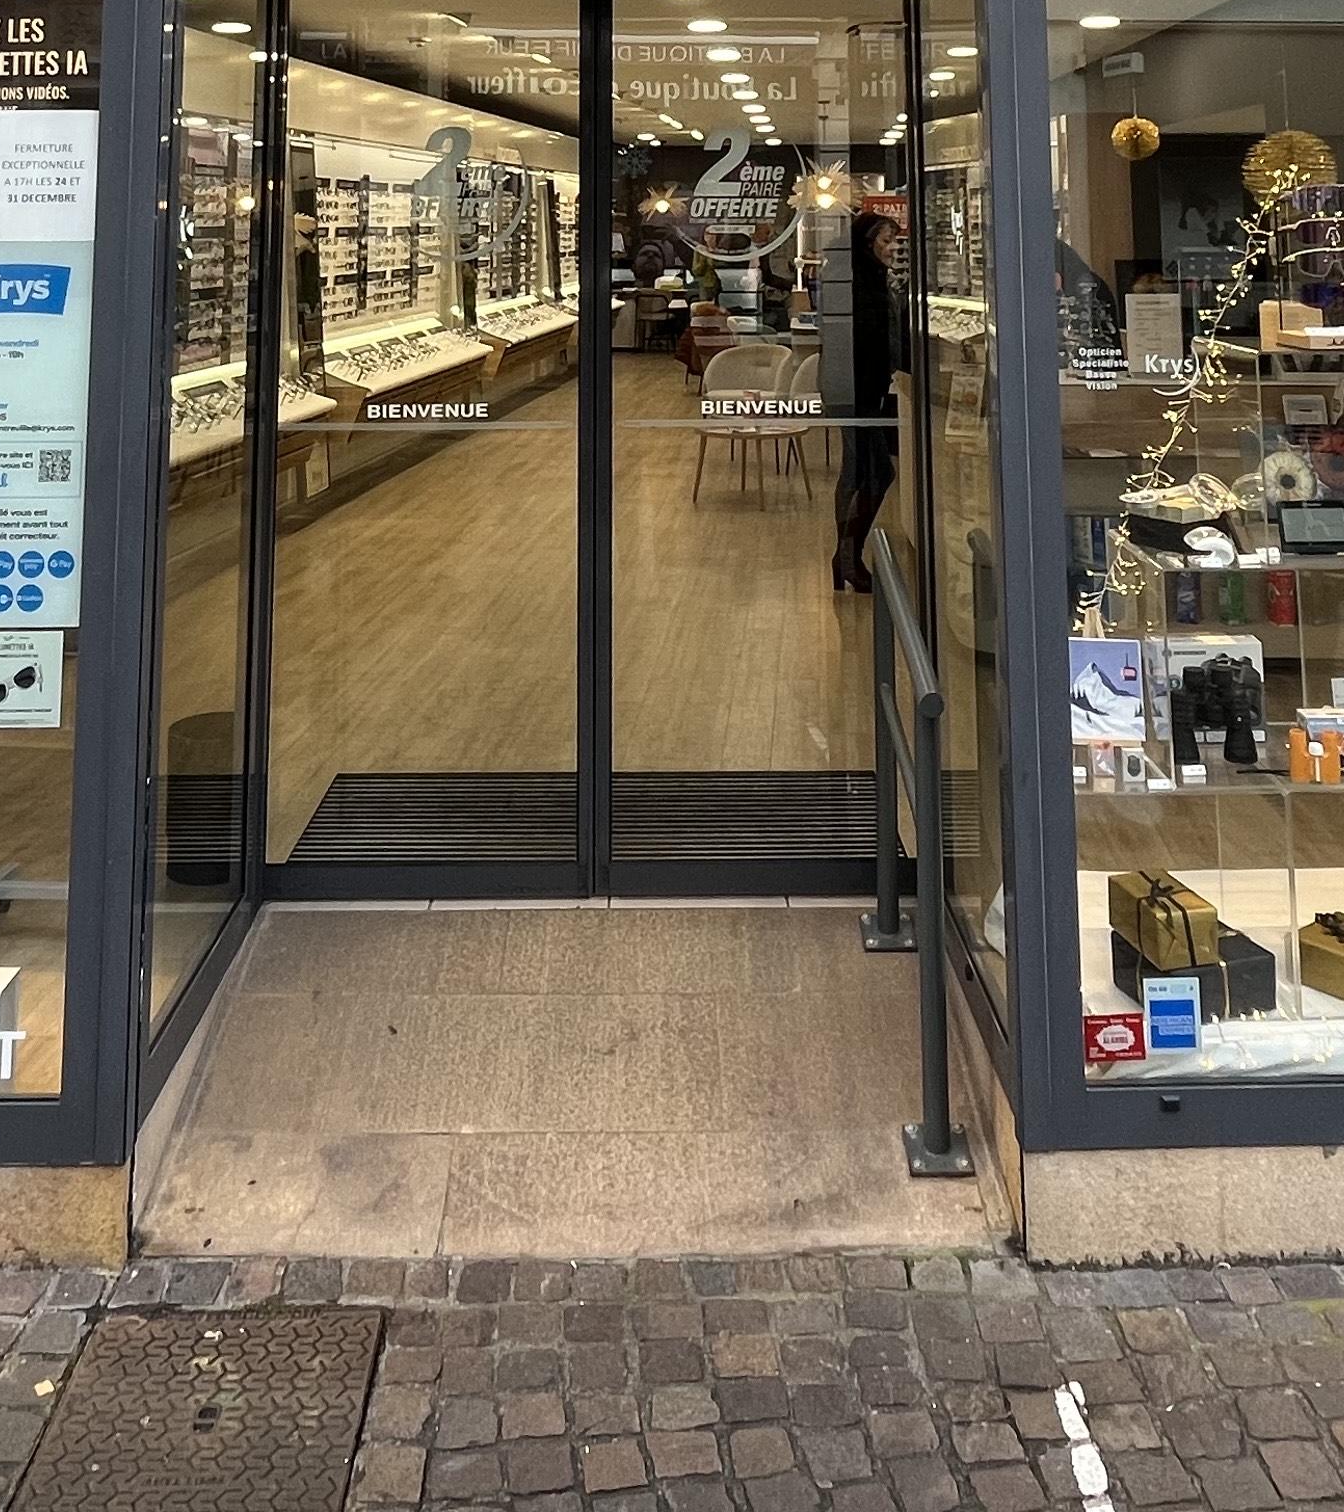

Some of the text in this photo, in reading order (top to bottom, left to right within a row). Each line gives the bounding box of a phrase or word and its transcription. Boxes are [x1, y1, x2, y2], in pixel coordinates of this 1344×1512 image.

[8, 18, 44, 43] LES
[67, 50, 88, 75] IA
[26, 83, 69, 100] VIDÉOS.
[15, 144, 73, 153] FERMETURE
[2, 160, 85, 169] EXCEPTIONNELLE
[15, 178, 32, 186] 17H
[70, 177, 80, 185] ET
[741, 182, 782, 197] PAIRE
[8, 194, 76, 202] 31 DECEMBRE
[691, 198, 779, 217] OFFERTE
[1079, 348, 1121, 356] Opticien
[1145, 355, 1194, 379] Krys
[1086, 381, 1118, 390] Vision
[366, 402, 489, 419] BIENVENUE
[701, 398, 823, 416] BIENVENUE
